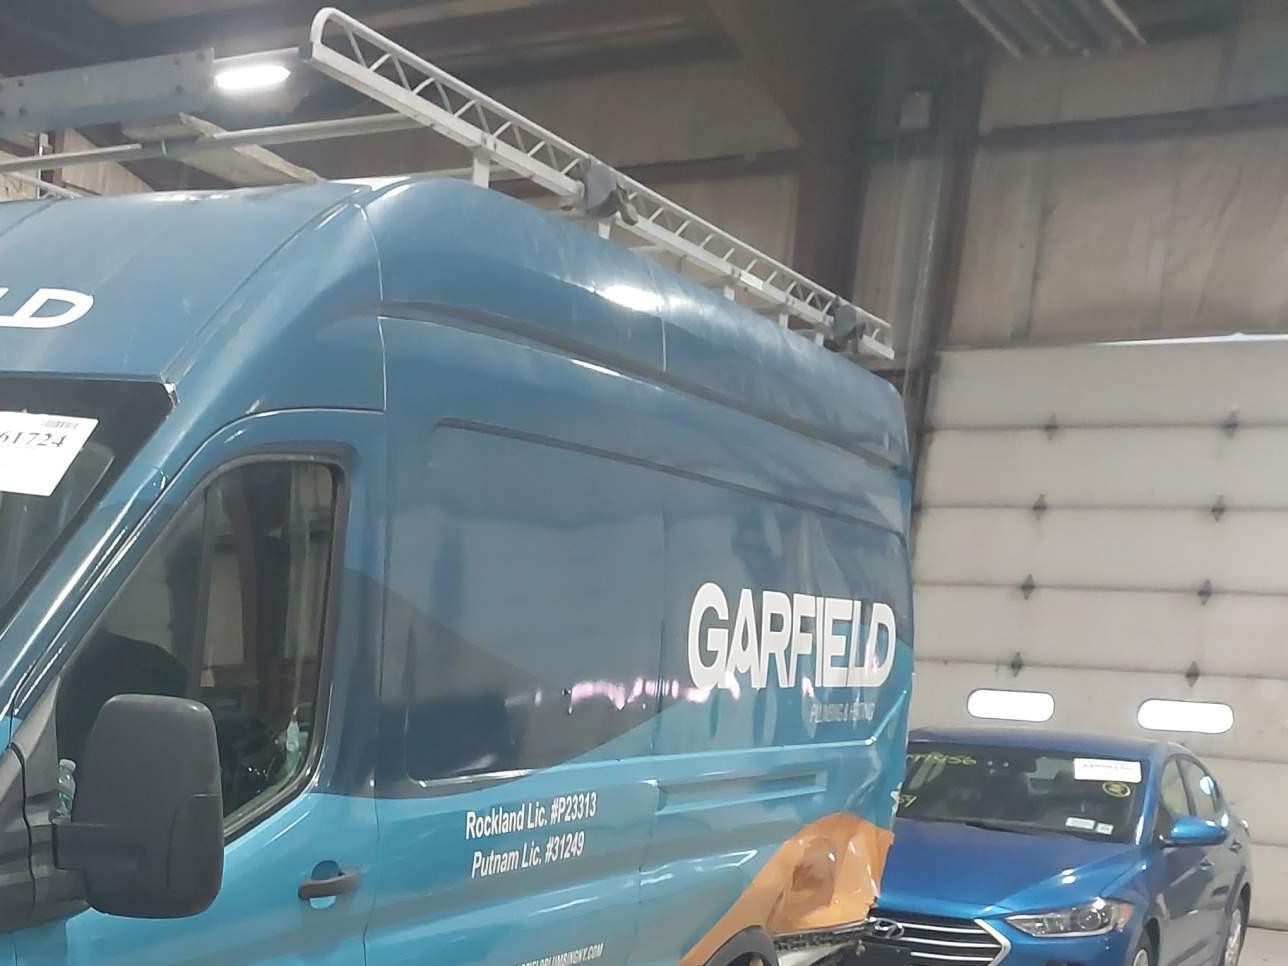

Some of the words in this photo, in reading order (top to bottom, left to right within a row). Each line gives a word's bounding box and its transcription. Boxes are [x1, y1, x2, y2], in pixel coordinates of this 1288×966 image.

[687, 582, 896, 689] GARFIELD
[465, 802, 525, 840] Rockland
[527, 800, 548, 829] Lic.
[550, 791, 597, 824] #P23313
[471, 848, 519, 879] Putnam
[521, 841, 542, 868] Lic.
[544, 830, 585, 864] #31249
